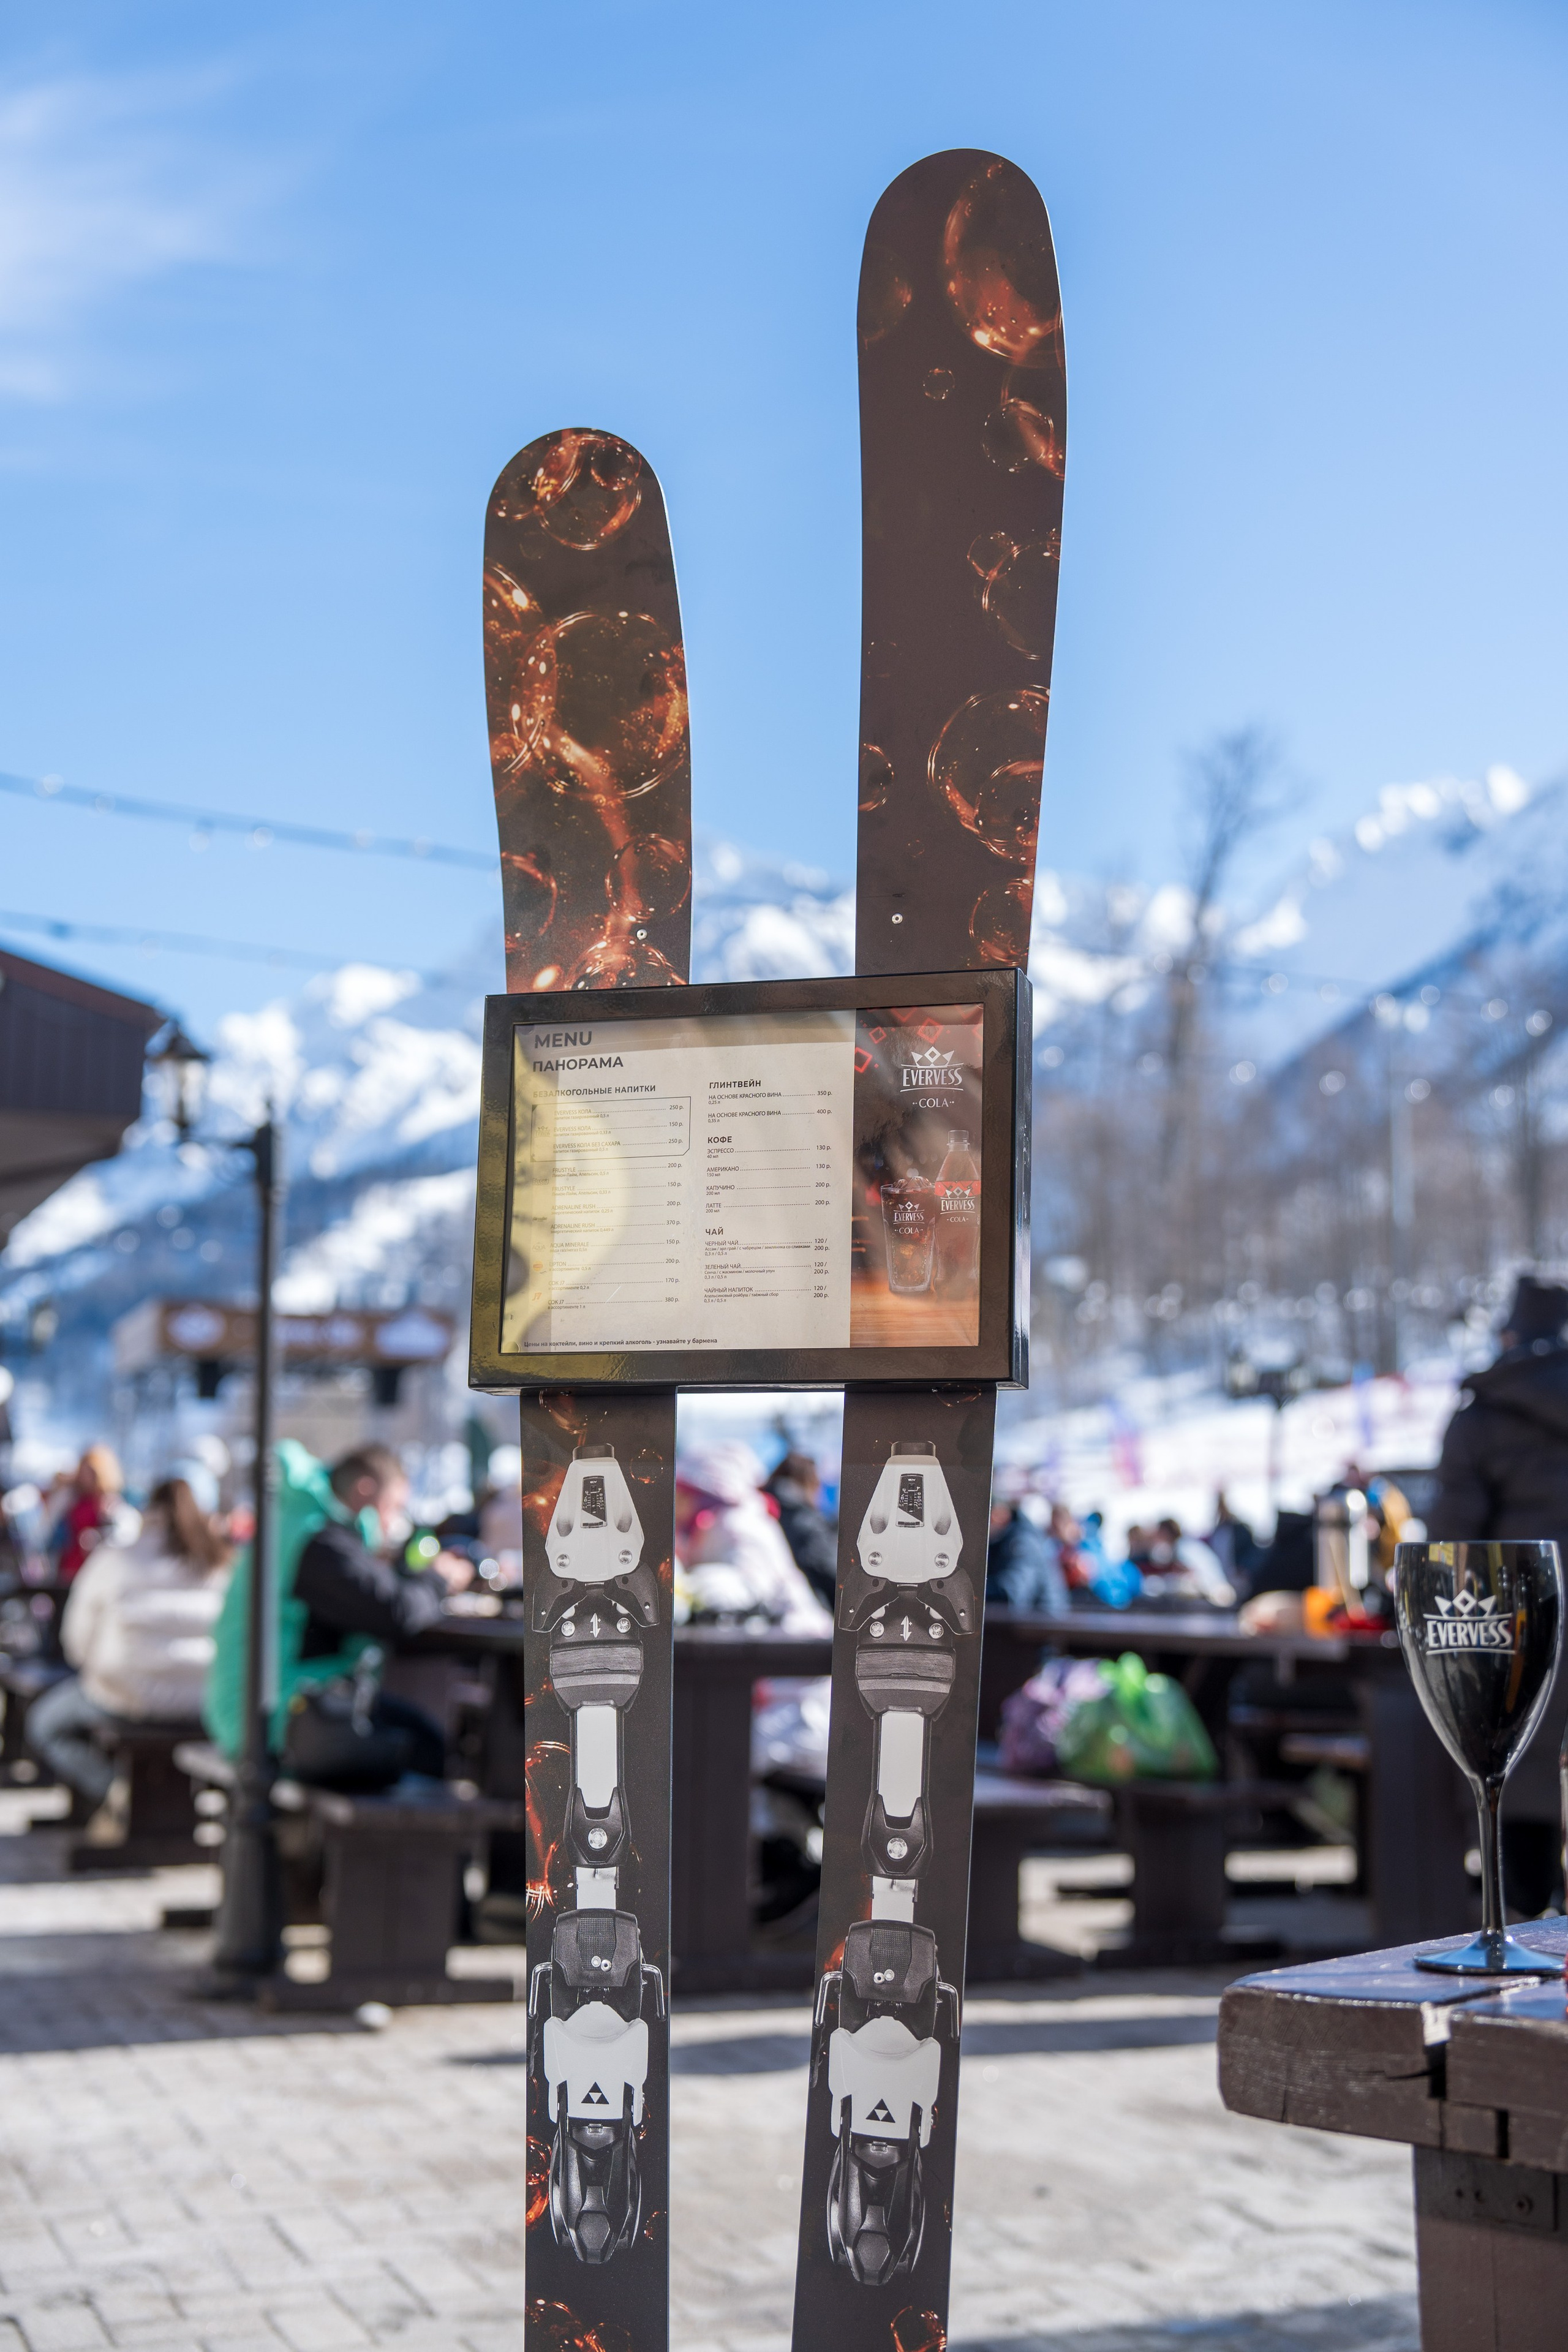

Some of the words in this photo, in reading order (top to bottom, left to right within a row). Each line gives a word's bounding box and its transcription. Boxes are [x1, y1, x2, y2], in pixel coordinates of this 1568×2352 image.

[534, 1031, 592, 1049] MENU
[533, 1056, 624, 1072] ПАНОРАМА
[902, 1067, 963, 1087] EVERVESS
[709, 1079, 761, 1089] ГЛИНТВЕЙН
[533, 1087, 612, 1098] БЕЗАЛКОГОЛЬНЫЕ
[615, 1085, 656, 1093] НАПИТКИ
[919, 1098, 949, 1108] COLA
[941, 1199, 975, 1211] EVERVESS
[894, 1212, 924, 1221] EVERVESS
[1427, 1621, 1513, 1648] EVERVESS
